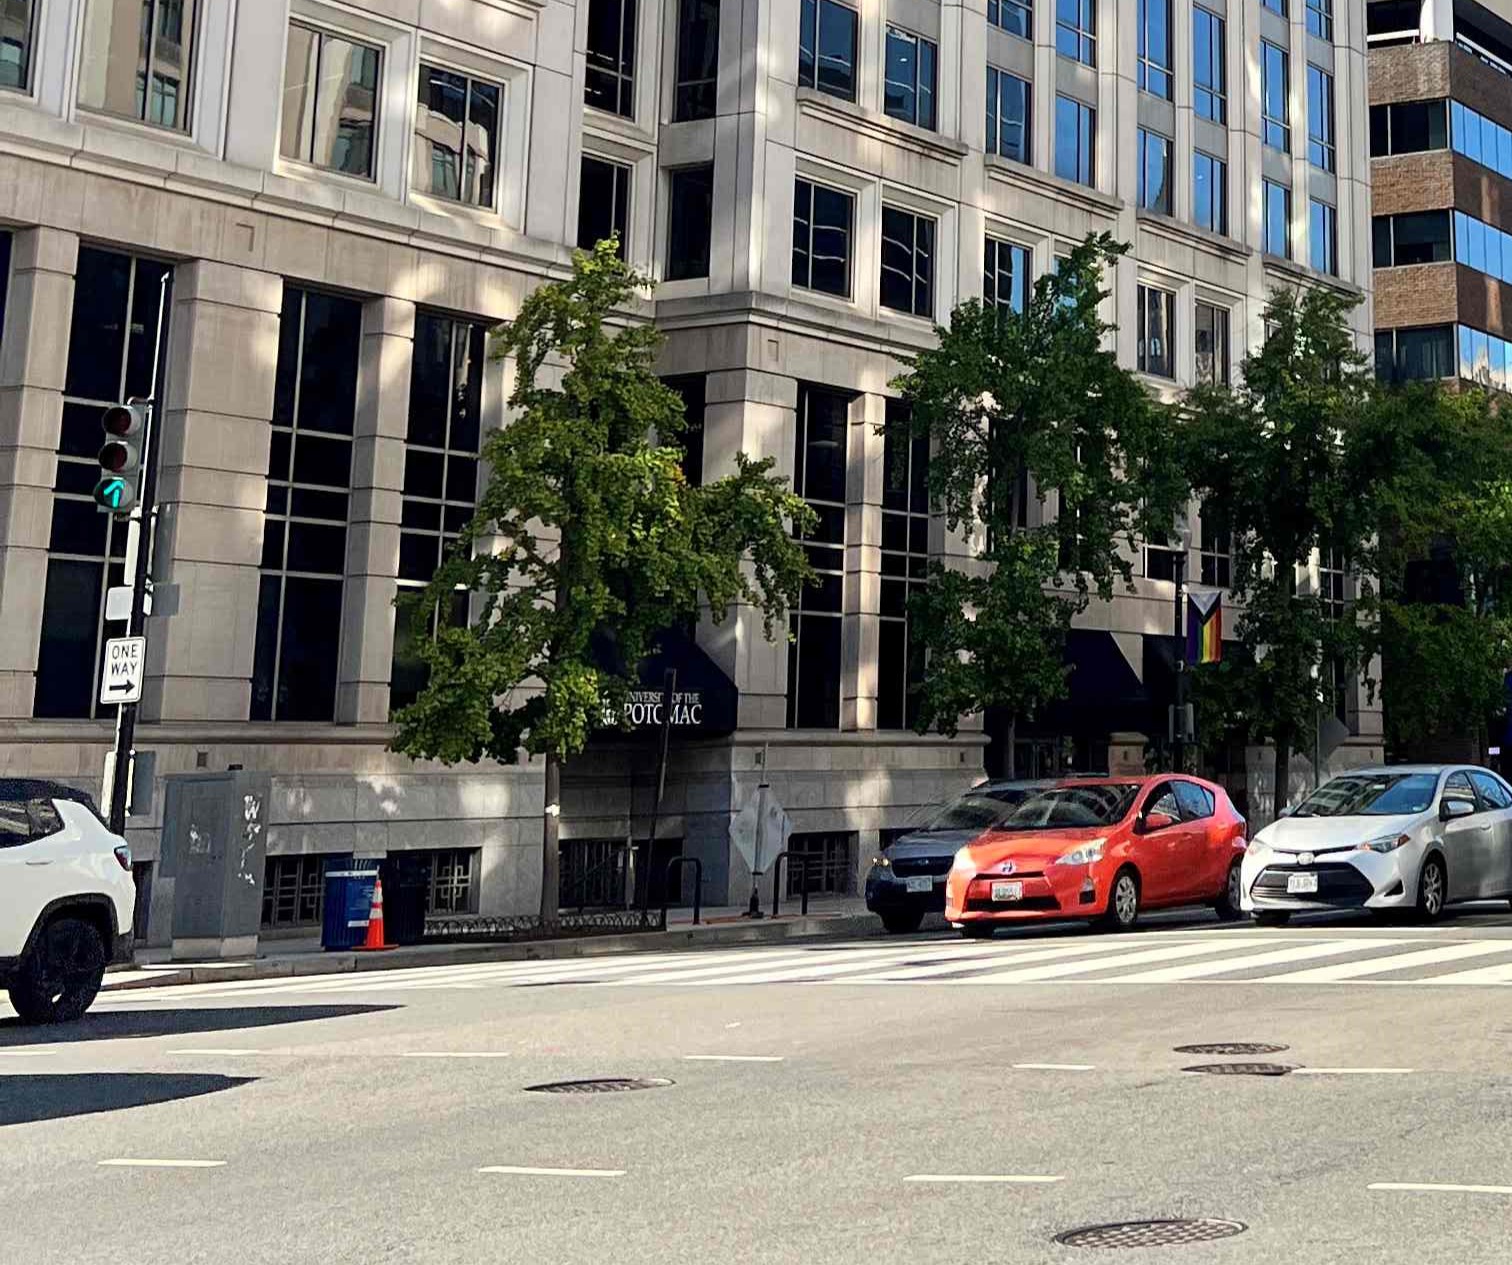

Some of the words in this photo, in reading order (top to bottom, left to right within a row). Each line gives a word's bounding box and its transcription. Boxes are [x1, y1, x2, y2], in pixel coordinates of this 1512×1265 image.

[112, 644, 138, 659] ONE
[111, 662, 138, 676] WAY
[624, 691, 664, 703] NIVERSI
[671, 692, 683, 704] OF
[684, 692, 700, 704] THE
